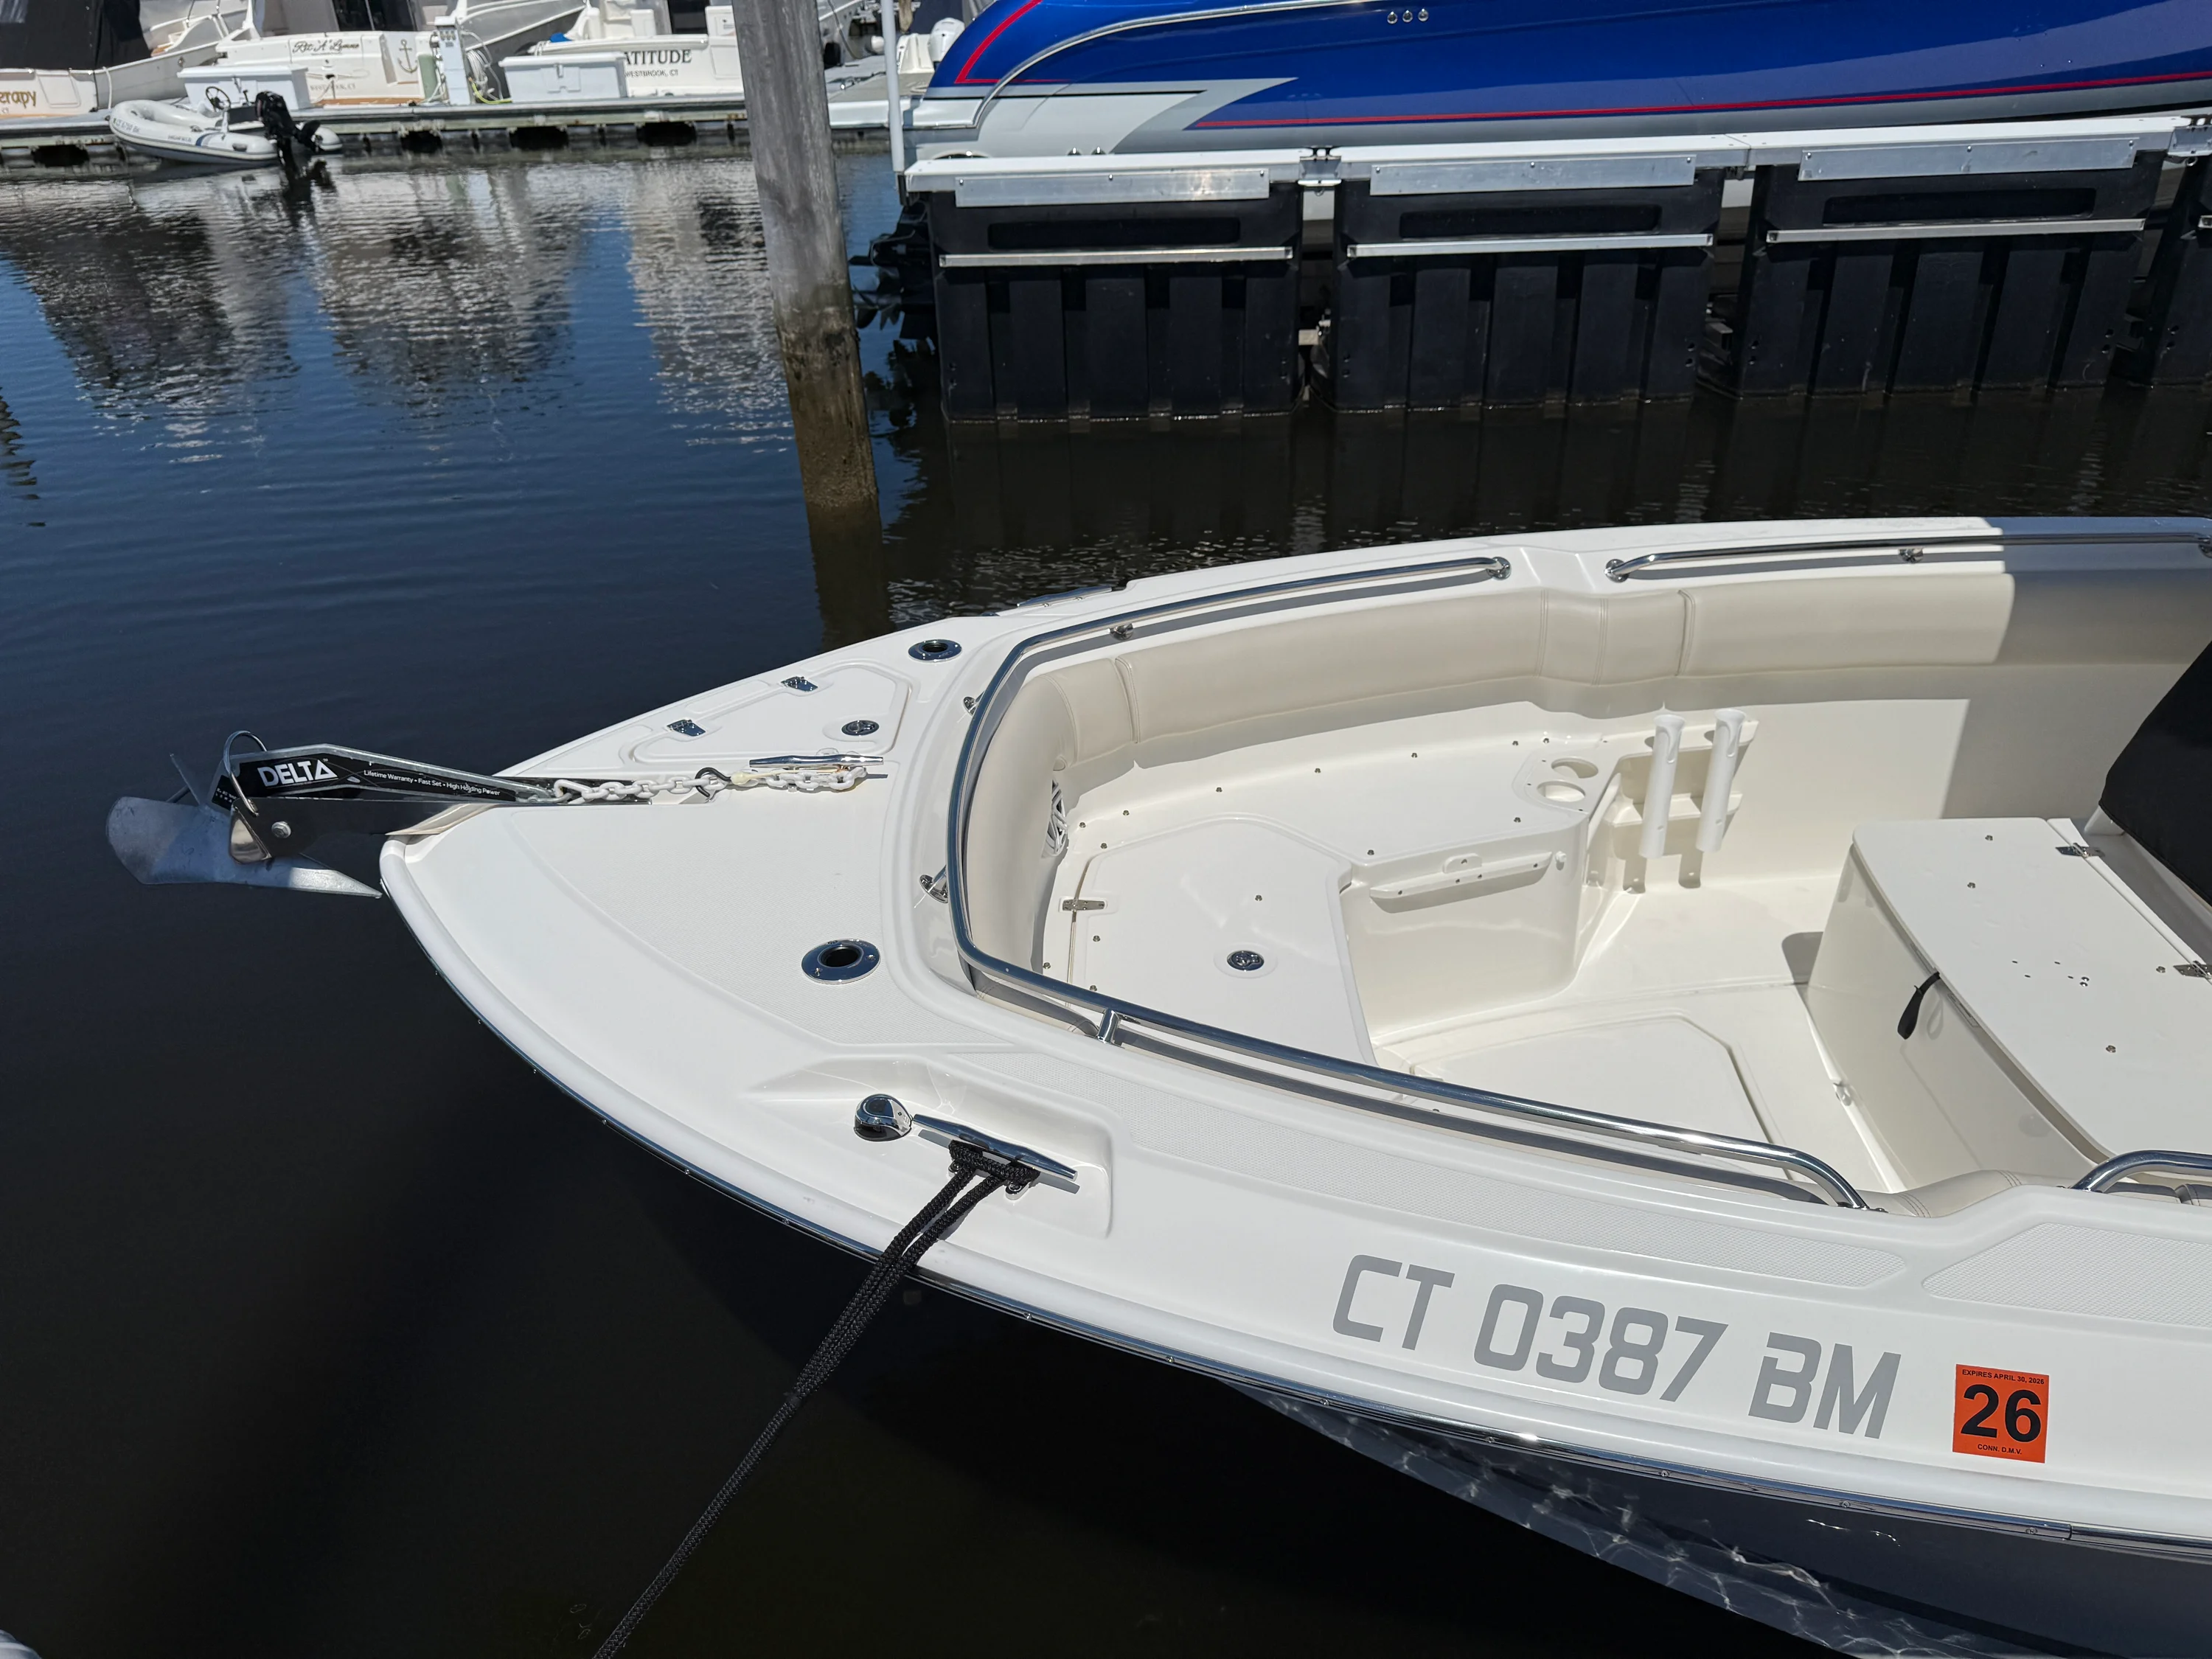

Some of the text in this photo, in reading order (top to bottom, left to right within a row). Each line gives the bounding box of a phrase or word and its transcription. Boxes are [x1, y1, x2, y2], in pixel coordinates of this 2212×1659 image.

[257, 759, 338, 787] DELTA
[364, 770, 387, 779] Lifetime
[387, 773, 414, 783] Warranty
[460, 785, 482, 794] Holding
[1332, 1254, 1902, 1439] CT 0387 BM
[1962, 1368, 1992, 1378] EXPIRES
[1993, 1373, 2016, 1382] APRIL
[1961, 1384, 2041, 1442] 26
[1977, 1443, 2022, 1455] CONN. D.M.V.
